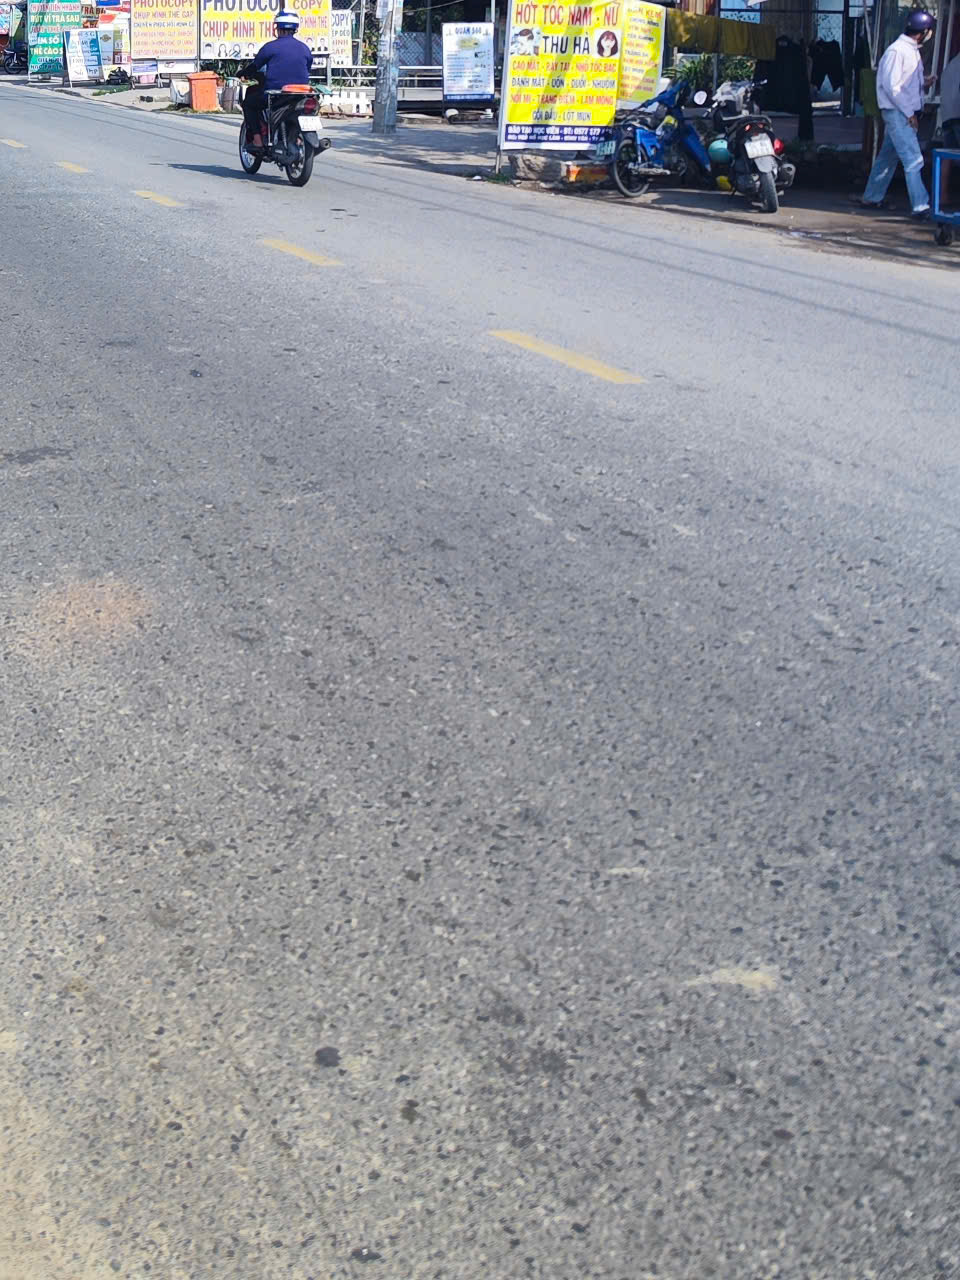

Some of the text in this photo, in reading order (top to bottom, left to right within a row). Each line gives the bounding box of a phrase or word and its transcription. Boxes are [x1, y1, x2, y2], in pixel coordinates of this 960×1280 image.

[293, 0, 324, 9] COPY
[515, 0, 538, 24] HỚT
[569, 6, 593, 26] NAM
[543, 32, 590, 54] THU HÀ
[537, 95, 557, 104] TRANG
